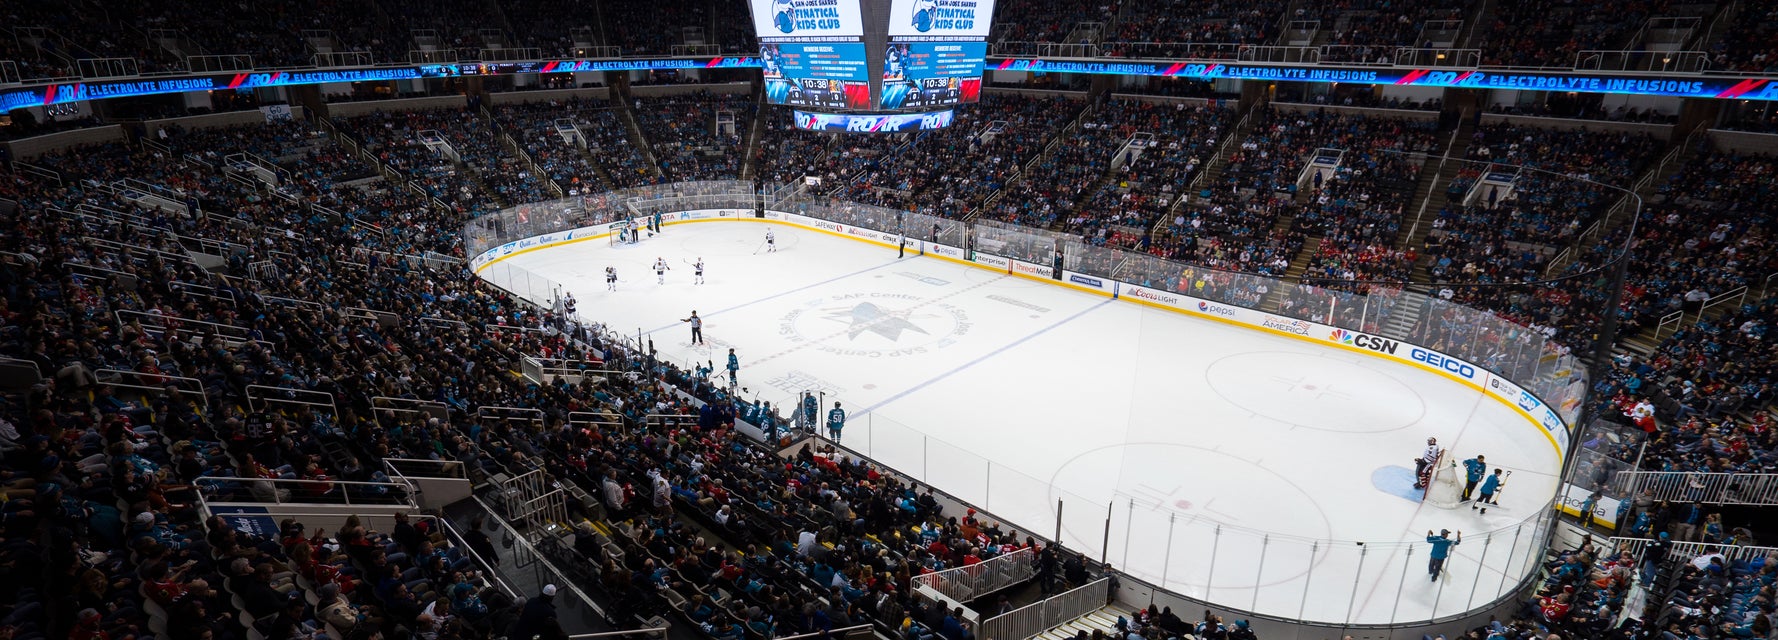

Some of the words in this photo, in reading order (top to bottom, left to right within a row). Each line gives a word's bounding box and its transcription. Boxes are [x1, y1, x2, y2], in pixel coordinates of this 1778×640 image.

[795, 8, 839, 19] FINATICAL
[936, 8, 974, 19] FINATICAL
[796, 20, 816, 30] KIDS
[818, 19, 840, 29] CLUB
[935, 20, 953, 29] KIDS
[955, 20, 973, 29] CLUB
[558, 60, 590, 72] ROAR
[594, 60, 648, 69] ELECTROLYTE
[652, 60, 694, 68] INFUSIONS
[722, 57, 754, 66] ROAR
[1013, 59, 1044, 70] ROAR
[1046, 62, 1104, 72] ELECTROLYTE
[1107, 63, 1156, 73] INFUSIONS
[250, 72, 290, 86] ROAR
[294, 70, 362, 82] ELECTROLYTE
[365, 68, 416, 79] INFUSIONS
[1184, 64, 1226, 77] ROAR
[1229, 67, 1306, 78] ELECTROLYTE
[1310, 70, 1377, 80] INFUSIONS
[804, 80, 827, 89] 10:38
[1425, 71, 1485, 86] ROAR
[1490, 76, 1599, 90] ELECTROLYTE
[1606, 79, 1703, 94] INFUSIONS
[58, 84, 87, 101] ROAR
[91, 80, 157, 96] ELECTROLYTE
[158, 78, 214, 90] INFUSIONS
[797, 117, 828, 130] ROAR
[846, 116, 903, 132] ROAR
[919, 115, 951, 130] ROAR
[815, 221, 836, 230] SAFEWAY
[940, 248, 957, 257] pepsi
[1016, 262, 1053, 278] ThreatMetri
[832, 292, 865, 301] SAP
[870, 292, 923, 301] Center
[1135, 287, 1157, 300] Coors
[1158, 294, 1178, 304] LIGHT
[1210, 304, 1235, 316] pepsi
[1264, 315, 1291, 324] SOLAR
[1262, 320, 1309, 336] AMERICA
[1354, 334, 1399, 354] CSN
[1411, 348, 1475, 379] GEICO
[1520, 394, 1536, 410] SAP
[833, 414, 842, 423] 50
